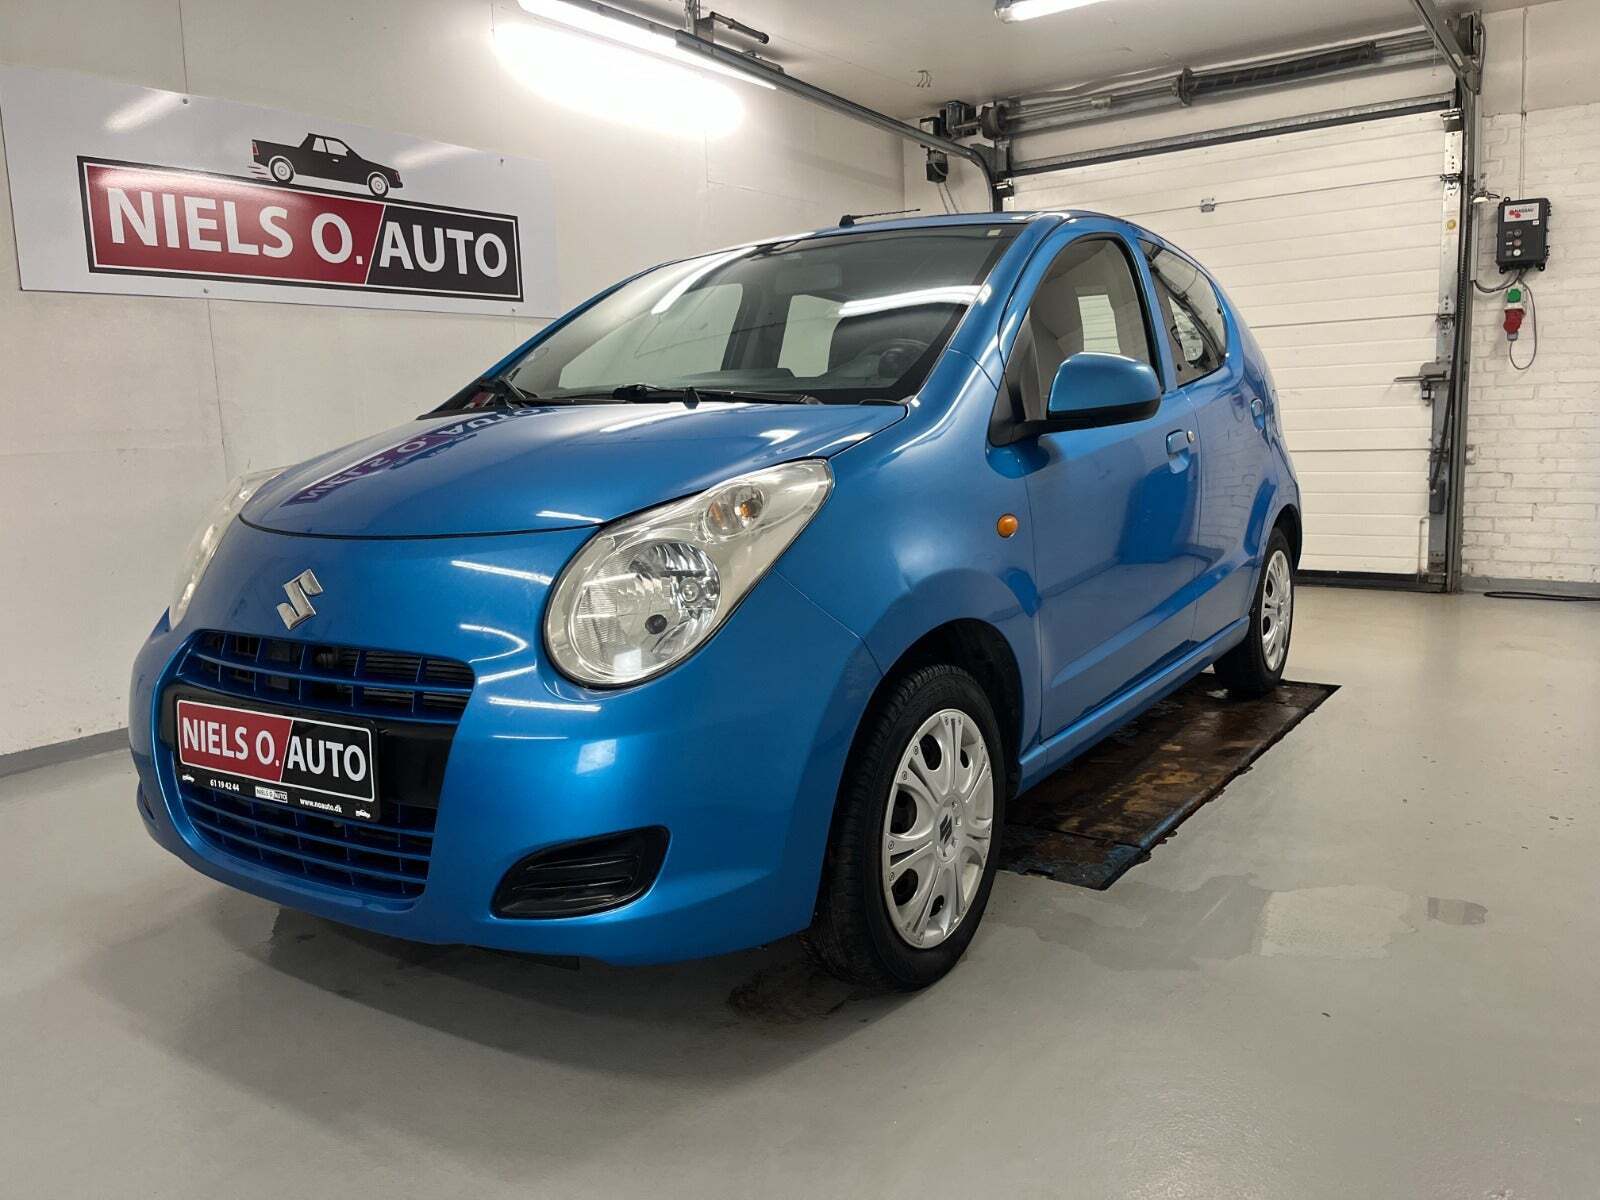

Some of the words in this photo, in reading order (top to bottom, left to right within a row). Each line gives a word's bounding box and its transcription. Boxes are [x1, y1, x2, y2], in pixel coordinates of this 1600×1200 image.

[107, 187, 294, 259] NIELS
[311, 213, 364, 265] O.
[378, 221, 508, 278] AUTO
[182, 717, 248, 760] NIELS
[255, 730, 280, 767] O.
[287, 736, 367, 782] AUTO
[209, 779, 217, 787] 61
[217, 780, 225, 788] 19
[225, 782, 232, 790] 42
[232, 783, 240, 791] 44
[299, 798, 343, 814] www.noauto.dk
